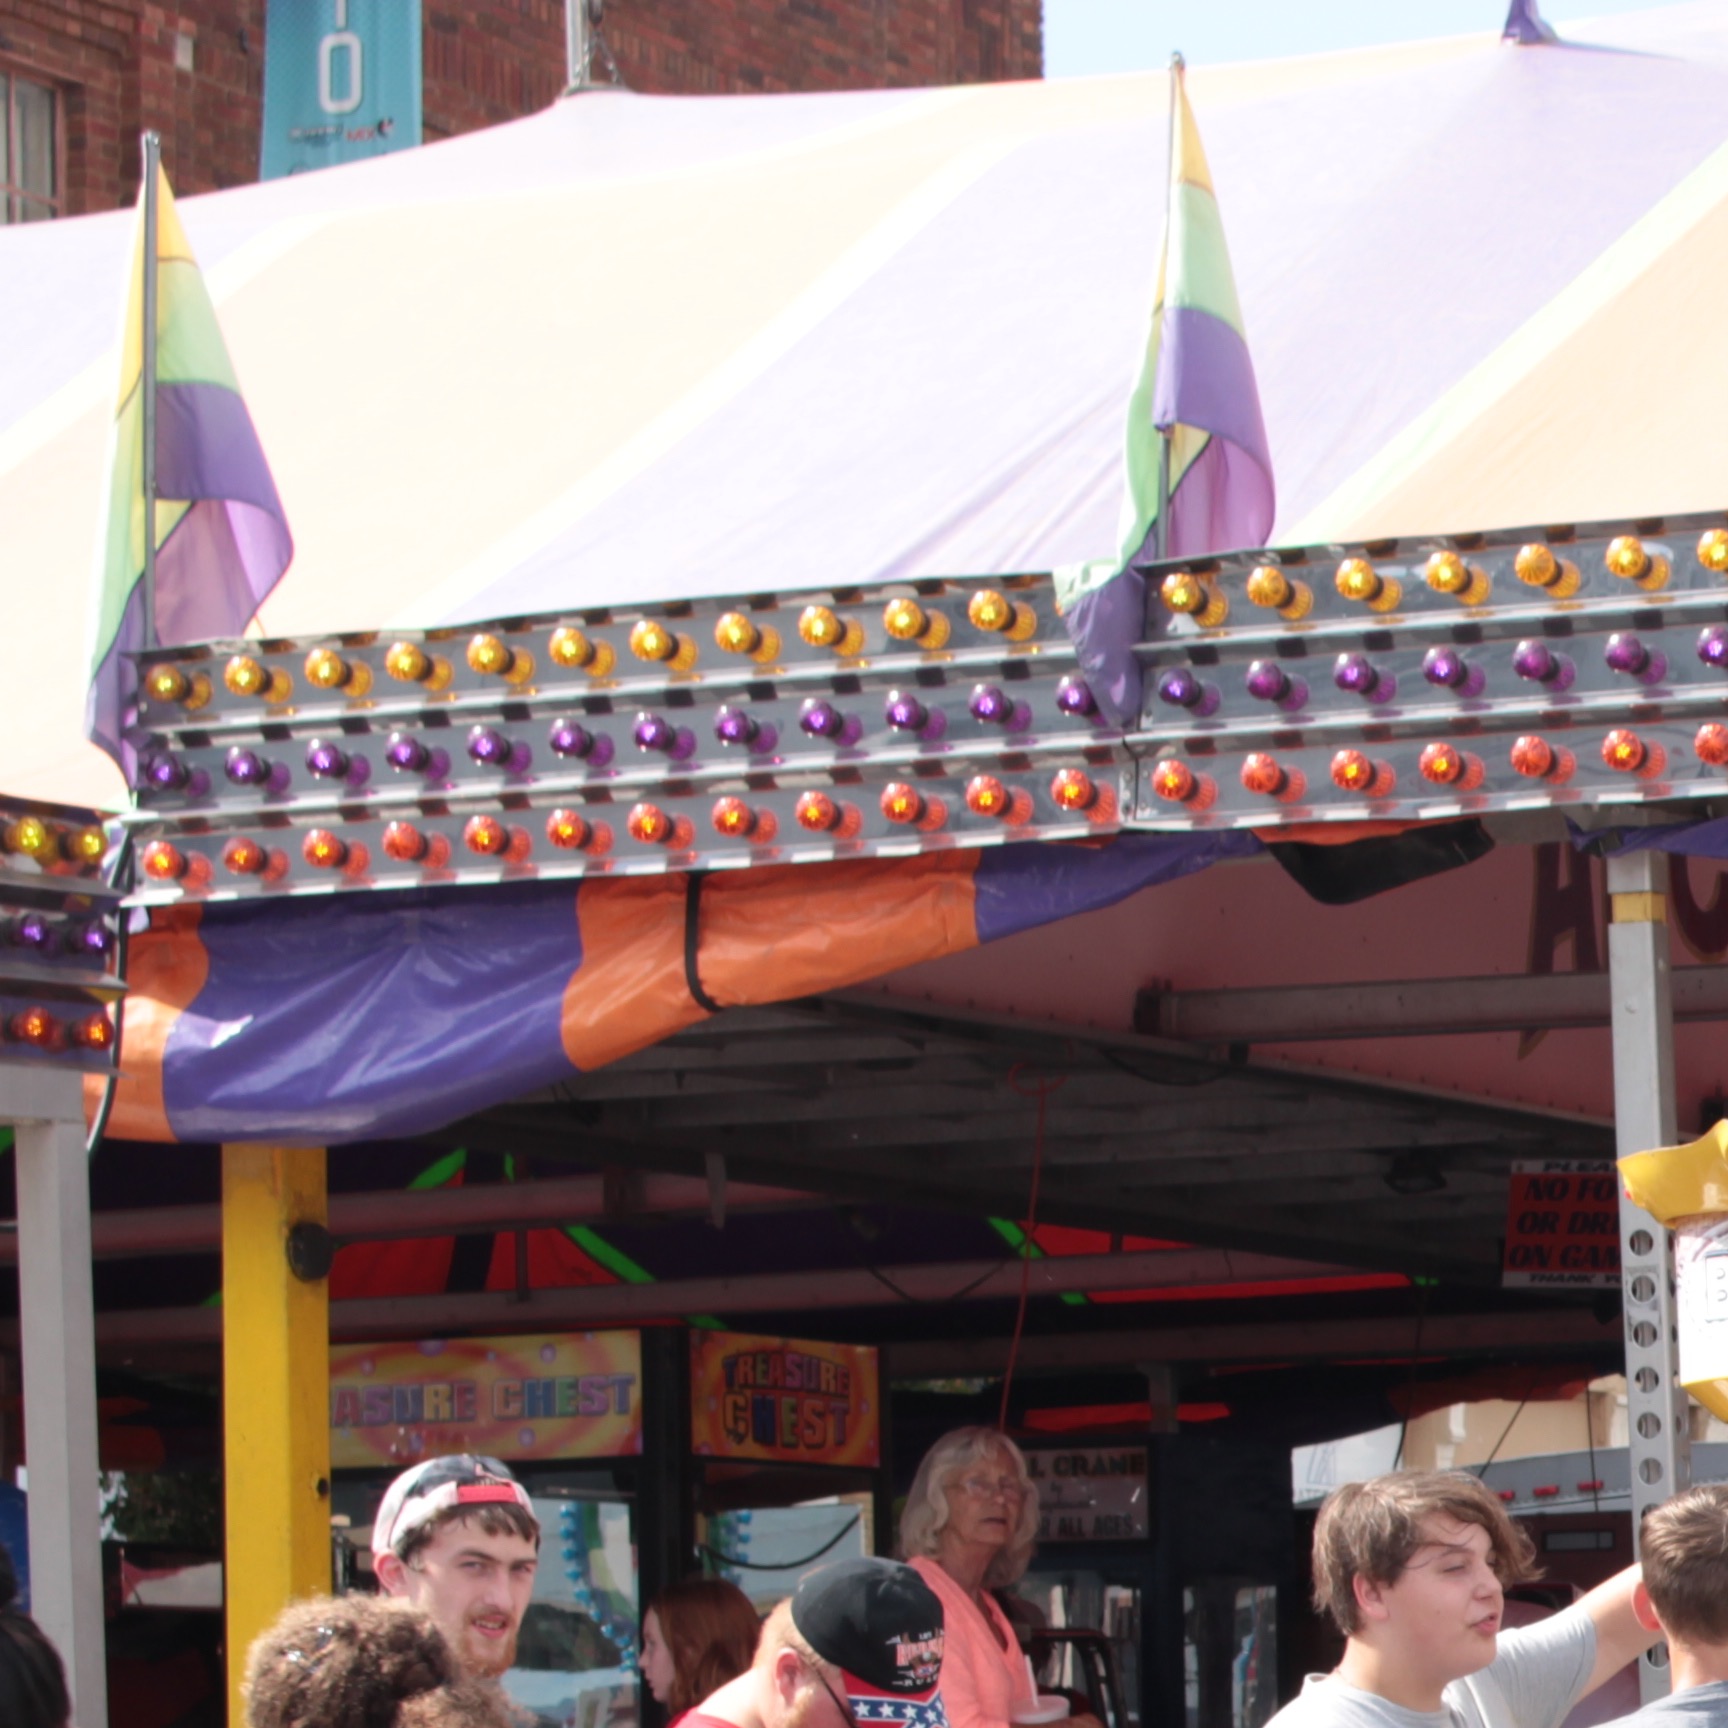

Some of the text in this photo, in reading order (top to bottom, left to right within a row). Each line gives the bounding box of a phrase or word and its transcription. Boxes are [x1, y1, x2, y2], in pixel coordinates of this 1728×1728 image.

[1543, 1161, 1615, 1172] PLEA
[1524, 1178, 1618, 1201] NO FO
[1516, 1211, 1560, 1234] OR
[1509, 1244, 1552, 1268] ON
[722, 1352, 851, 1396] TREASURE
[332, 1373, 637, 1427] ASURE CHEST
[723, 1393, 850, 1448] CHEST
[1058, 1515, 1086, 1538] ALL
